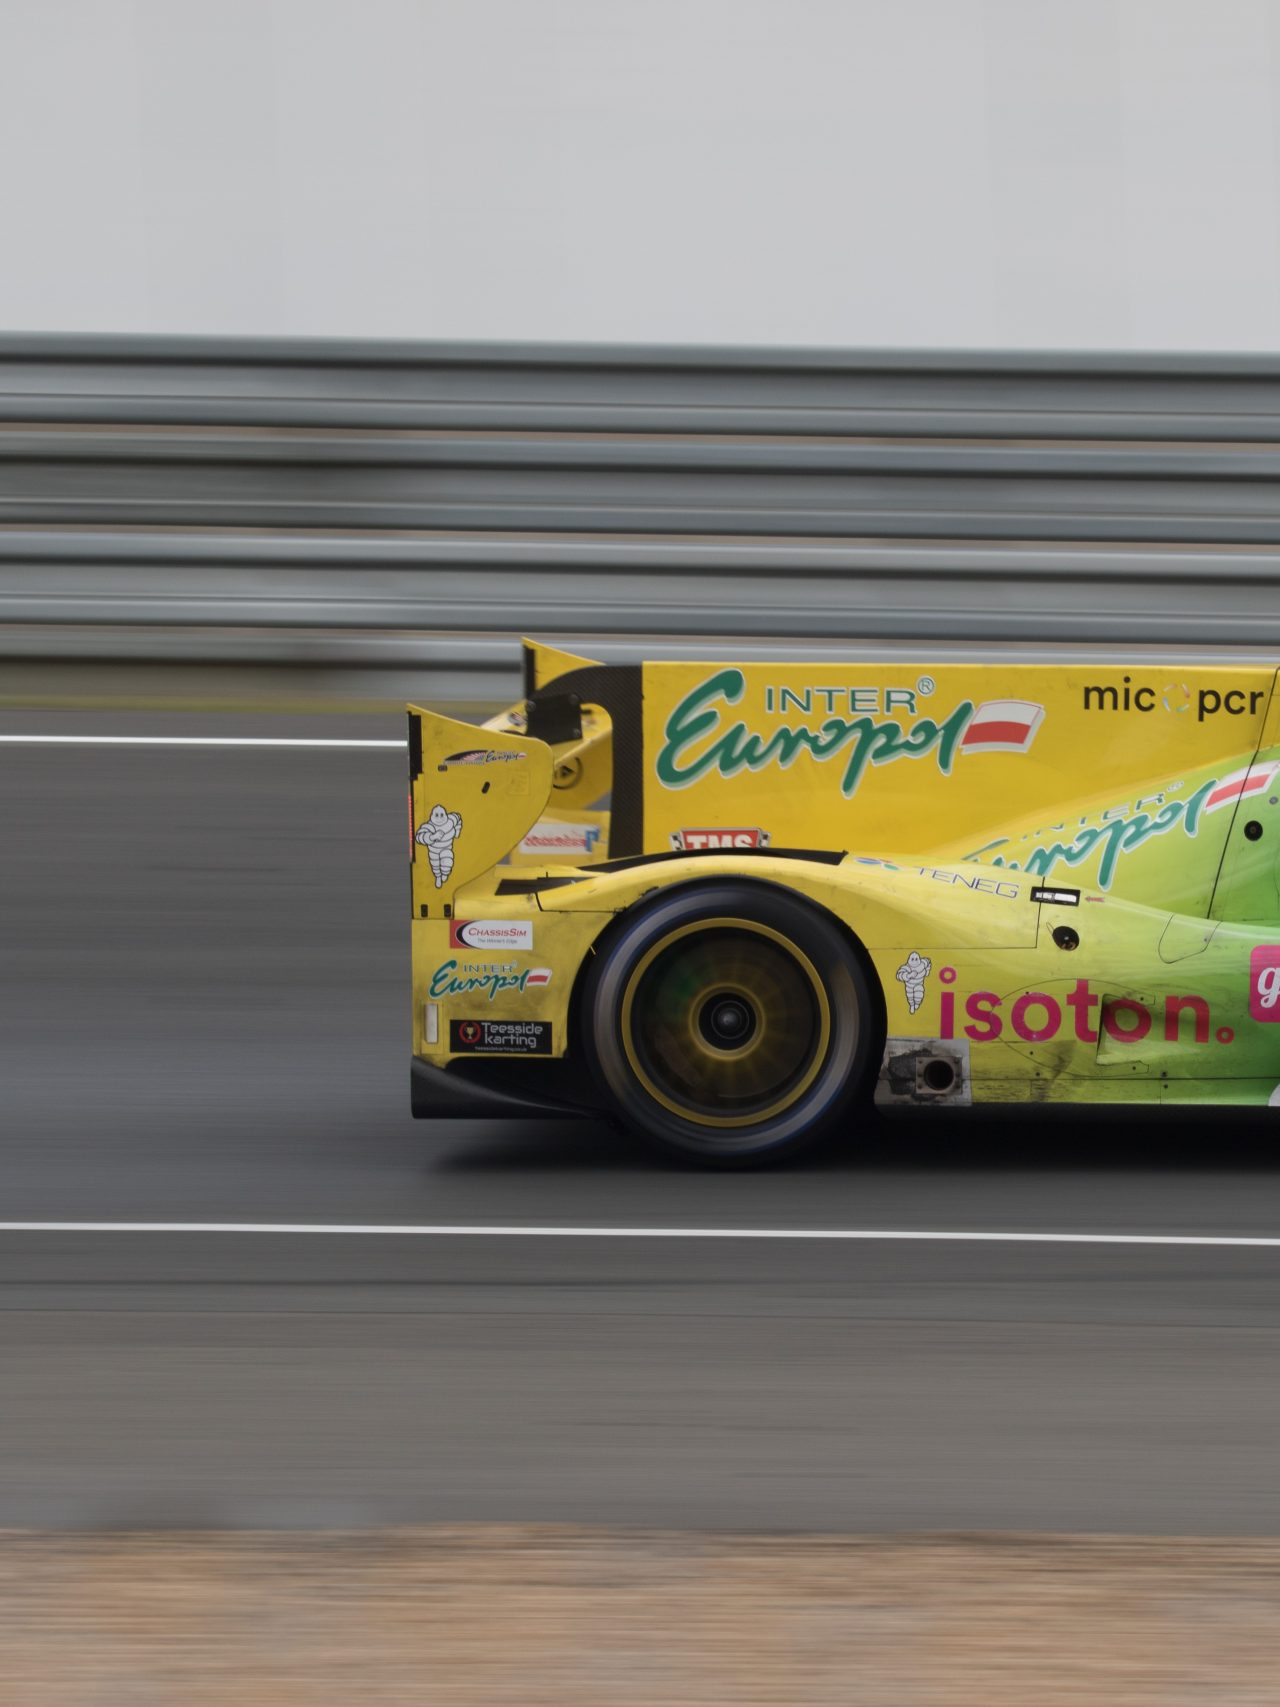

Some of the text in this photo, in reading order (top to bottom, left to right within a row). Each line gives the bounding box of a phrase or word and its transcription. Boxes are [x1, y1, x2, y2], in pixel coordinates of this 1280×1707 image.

[656, 668, 974, 797] Europol
[915, 866, 1020, 899] TENEG
[429, 959, 531, 1000] Europol
[481, 1022, 543, 1035] Teesside
[485, 1034, 537, 1048] karting
